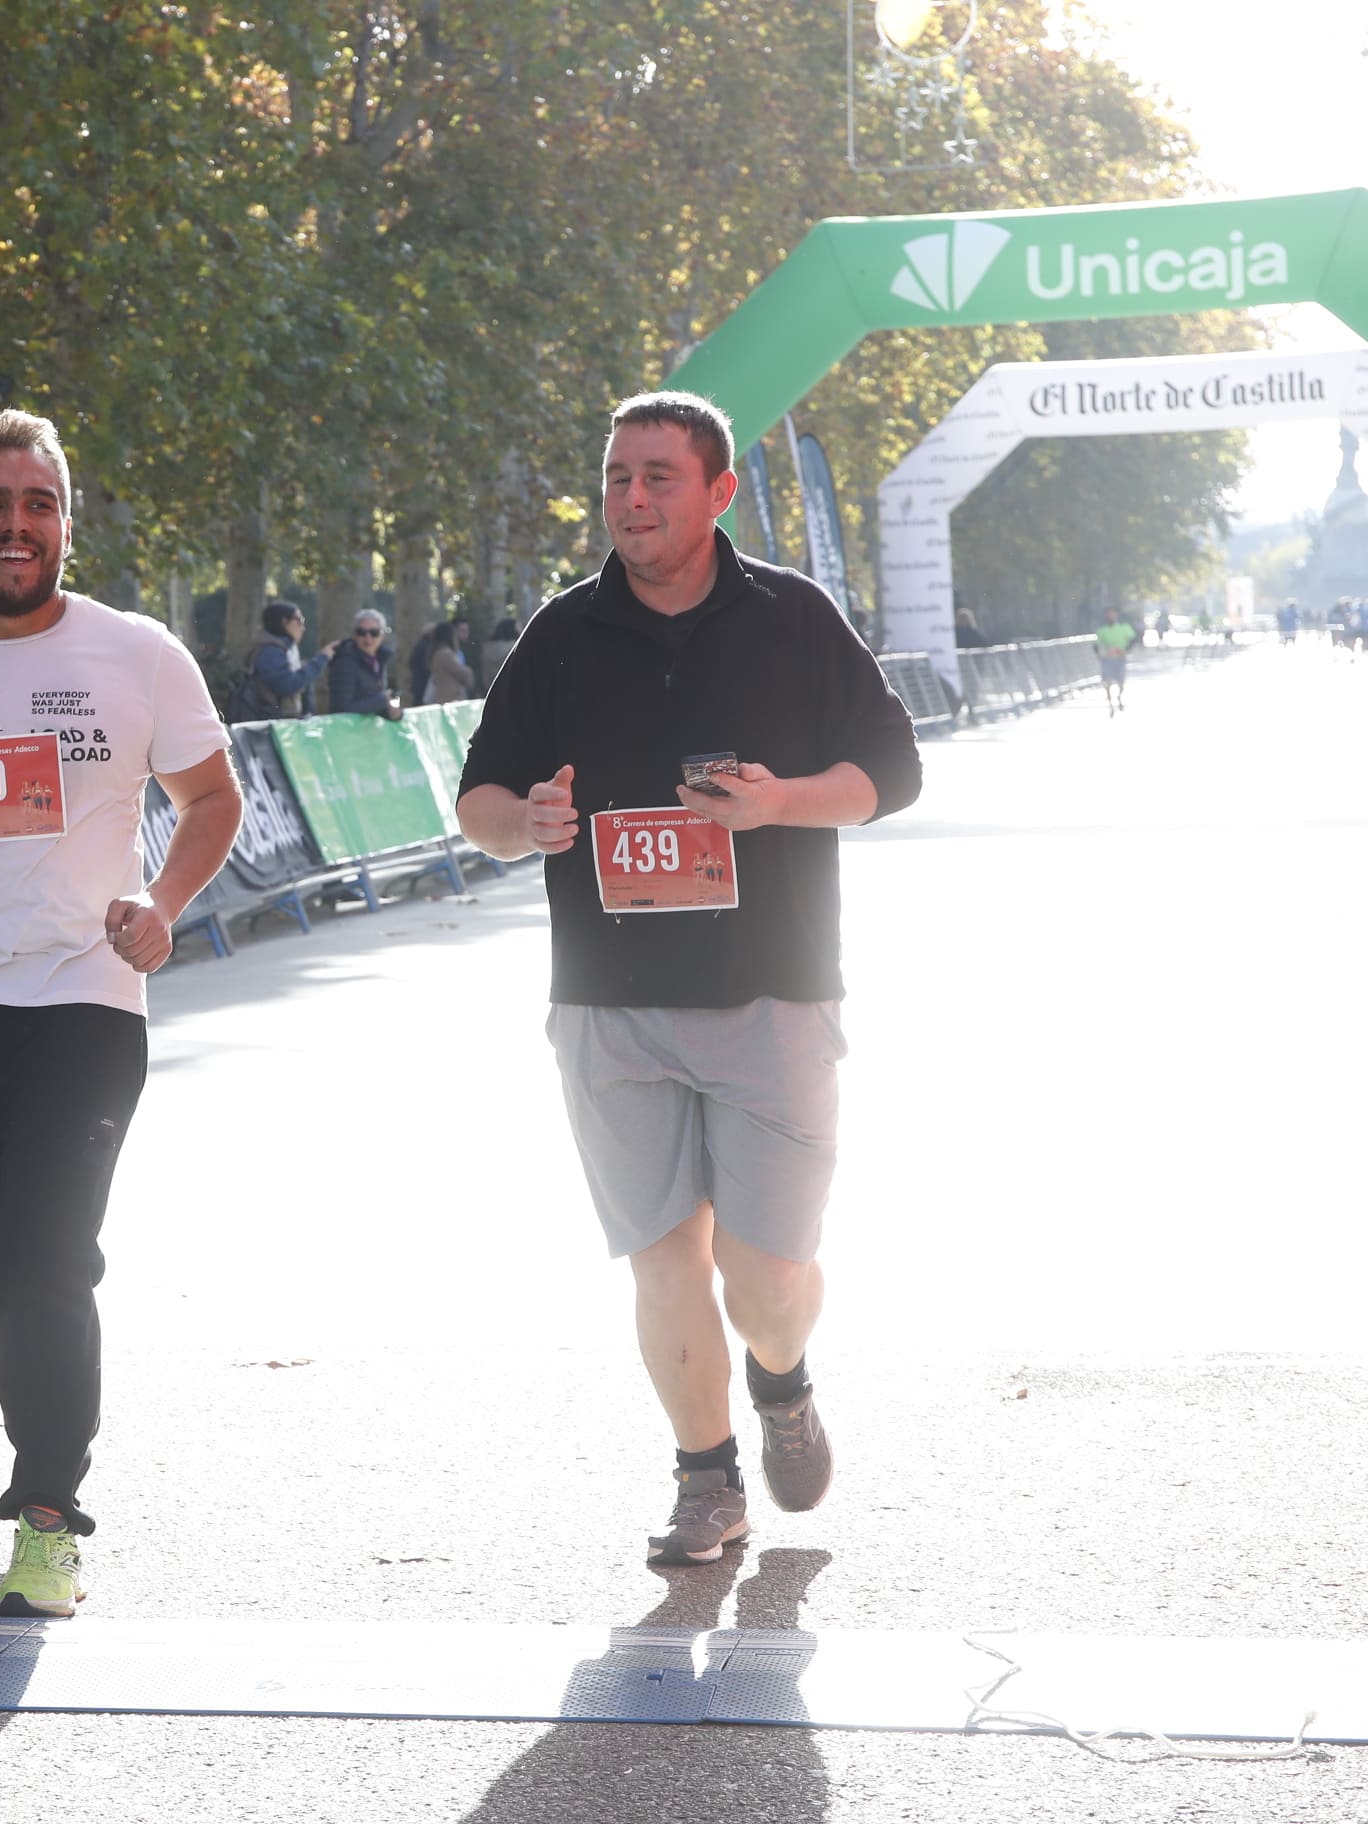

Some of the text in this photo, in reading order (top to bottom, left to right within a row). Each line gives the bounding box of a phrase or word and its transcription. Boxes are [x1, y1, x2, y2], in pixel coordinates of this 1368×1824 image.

[1026, 229, 1289, 300] Unicaja
[1029, 368, 1327, 417] El Norte de Castilla
[32, 691, 91, 699] EVERYBODY
[32, 699, 82, 707] WAS JUST
[32, 707, 96, 716] SO FEARLESS
[31, 728, 108, 743] AD &
[14, 744, 40, 753] Adecco
[655, 819, 684, 827] empresas
[612, 829, 680, 873] 439
